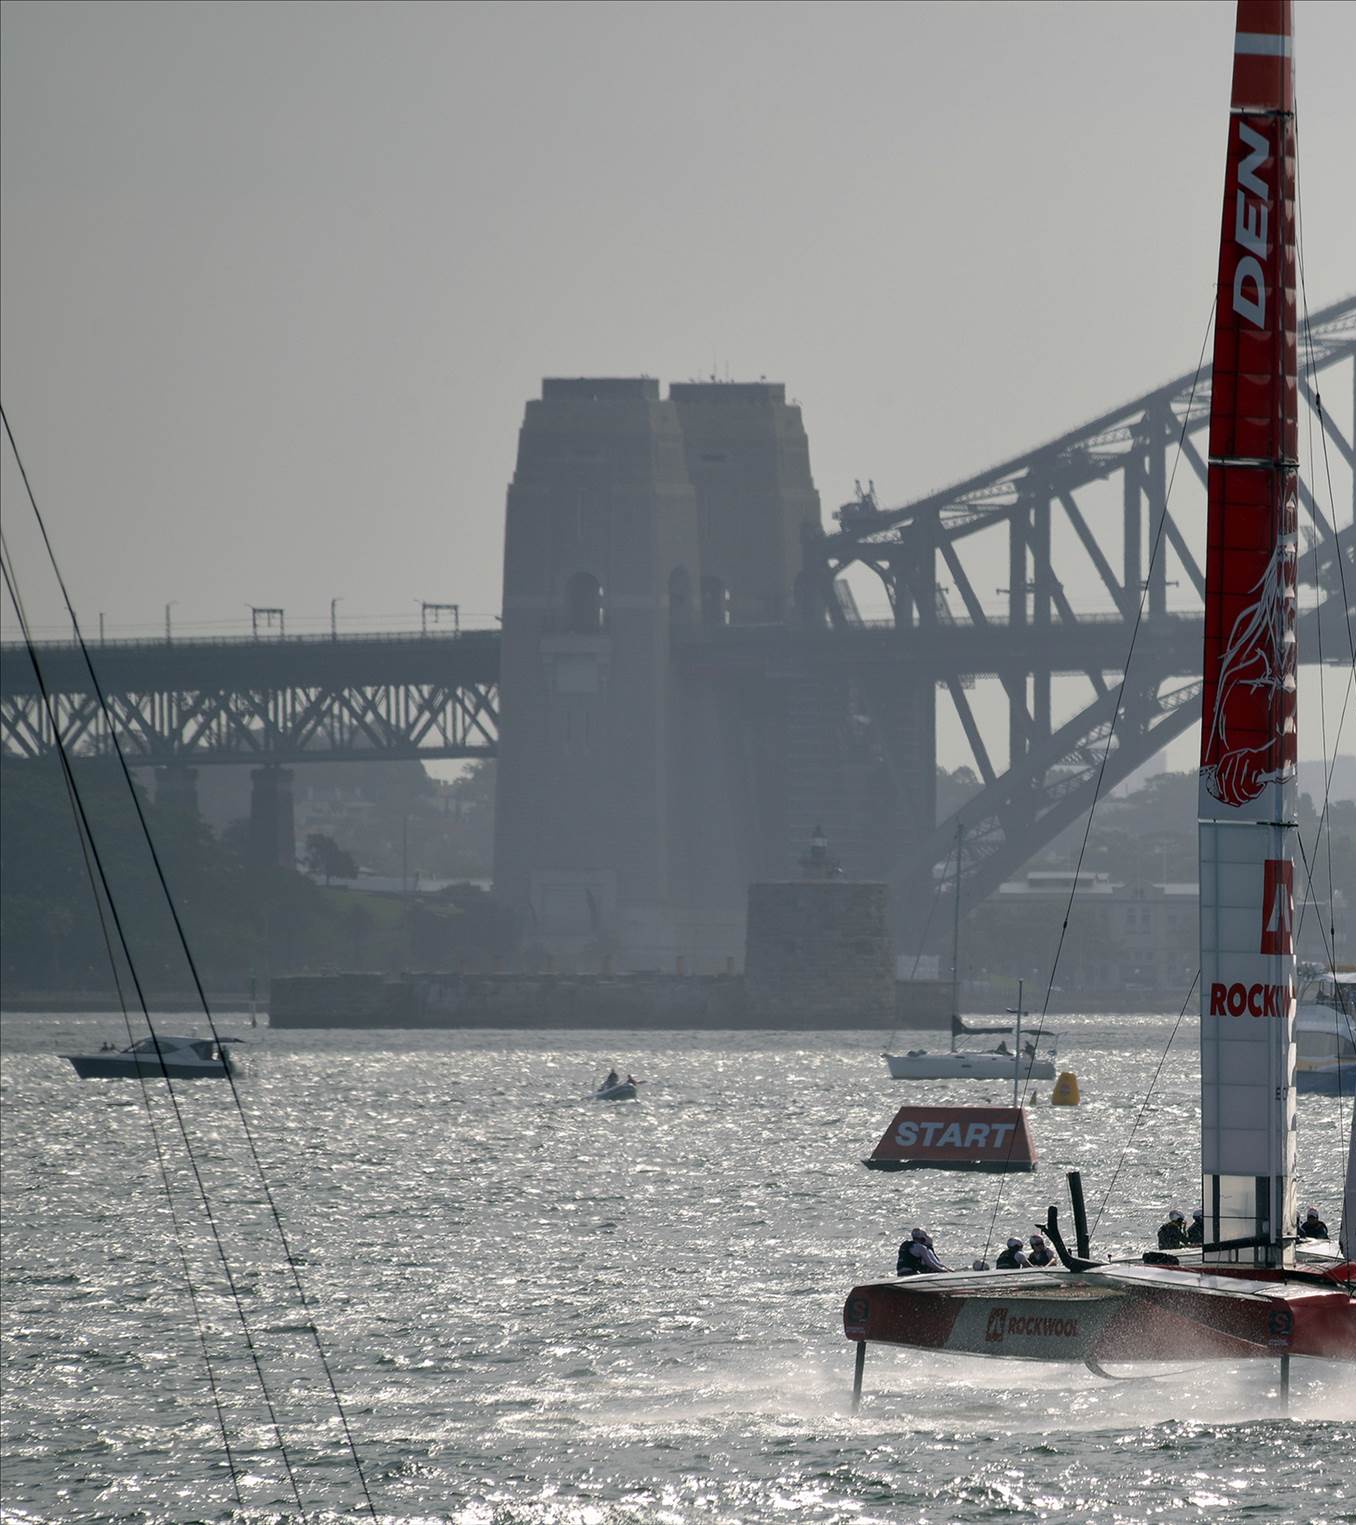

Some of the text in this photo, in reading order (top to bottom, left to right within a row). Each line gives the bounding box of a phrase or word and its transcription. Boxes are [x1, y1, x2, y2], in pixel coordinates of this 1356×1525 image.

[1233, 121, 1269, 330] DEN
[895, 1121, 1016, 1148] START
[1008, 1316, 1080, 1337] ROCKWOOL
